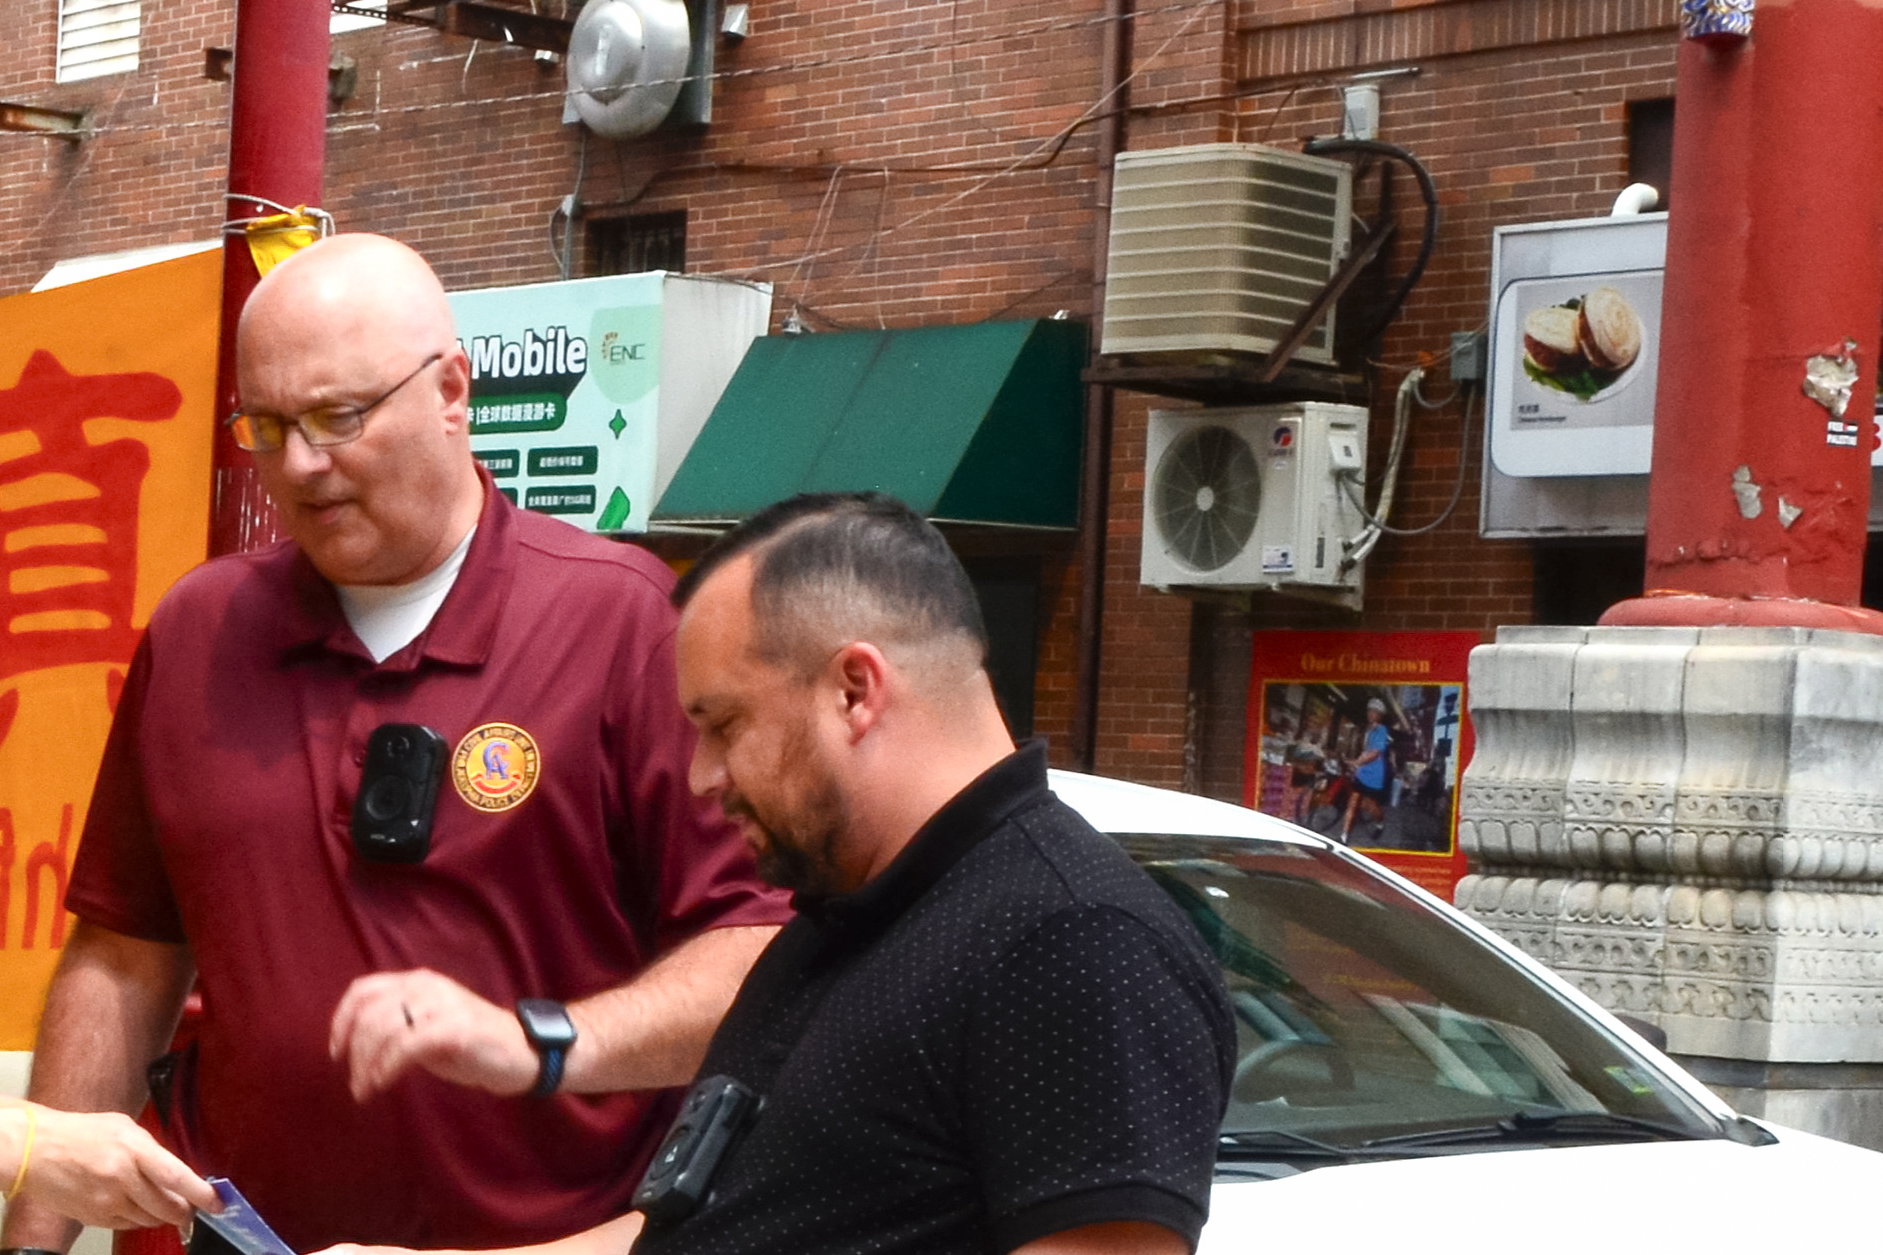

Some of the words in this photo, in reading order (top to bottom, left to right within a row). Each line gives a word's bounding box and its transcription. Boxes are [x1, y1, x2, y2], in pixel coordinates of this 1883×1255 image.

[471, 326, 587, 380] Mobile
[1300, 653, 1334, 672] Our
[1338, 653, 1430, 673] Chinatown
